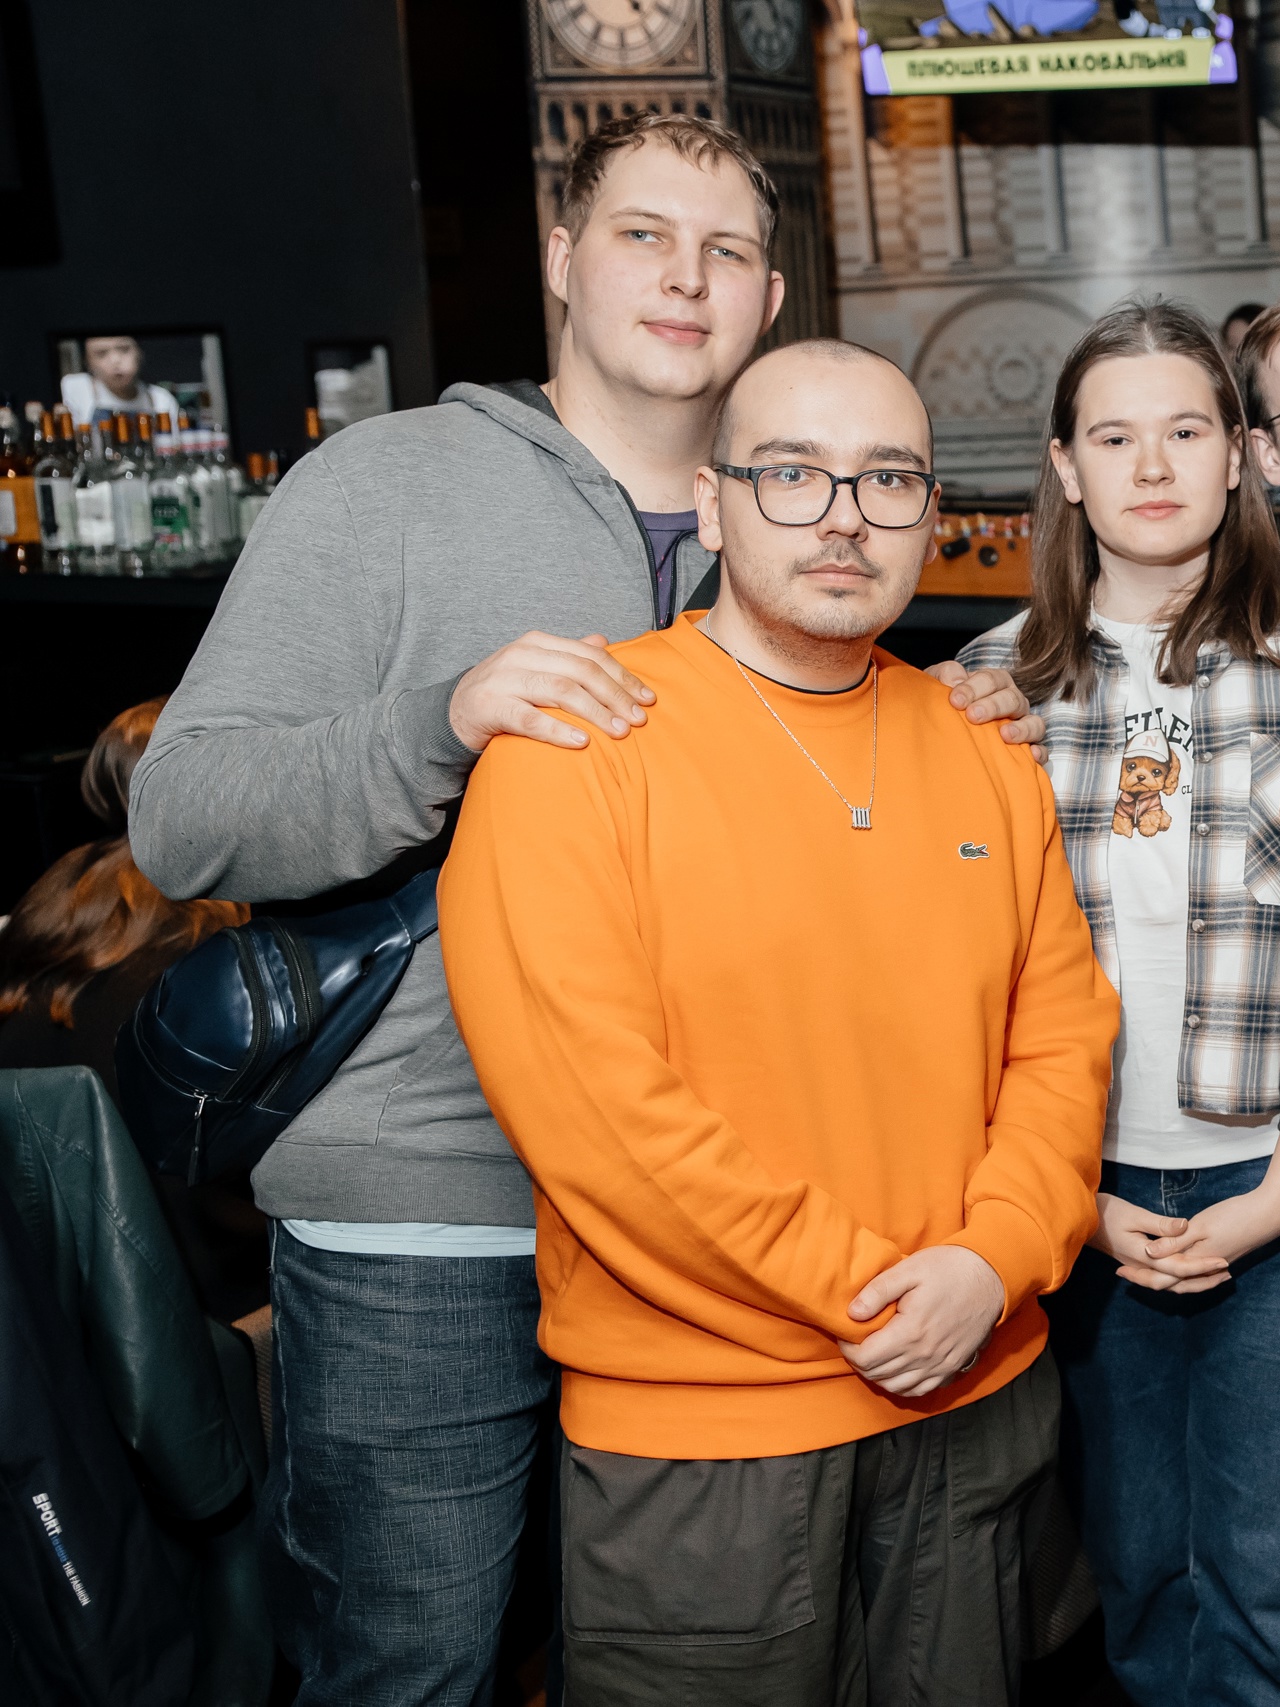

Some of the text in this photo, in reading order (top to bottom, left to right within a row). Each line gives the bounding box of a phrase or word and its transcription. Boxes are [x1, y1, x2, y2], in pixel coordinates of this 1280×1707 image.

[907, 50, 1187, 78] ПЛЮШЕВАЯ НАКОВАЛЬНЯ
[32, 1492, 63, 1537] SPORT
